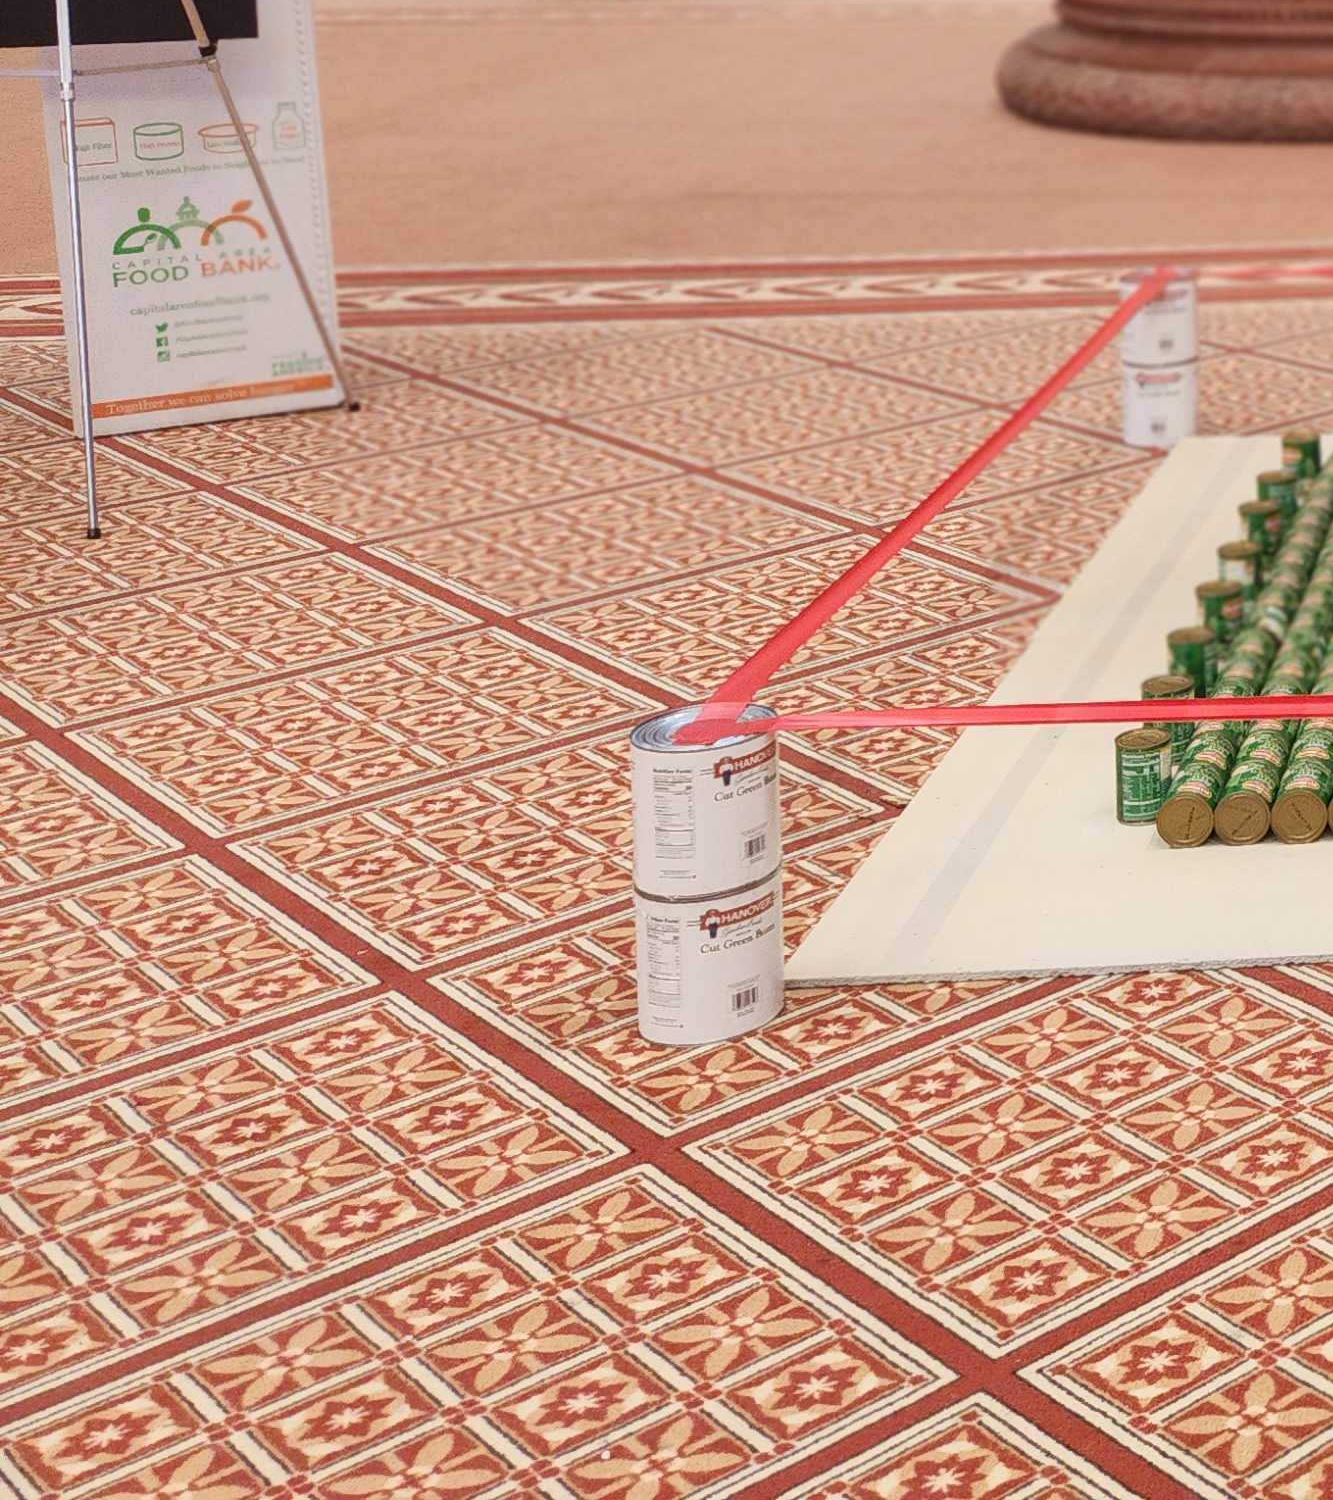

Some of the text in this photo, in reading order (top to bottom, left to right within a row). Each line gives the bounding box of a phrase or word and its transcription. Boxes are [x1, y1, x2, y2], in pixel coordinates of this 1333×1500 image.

[112, 253, 203, 271] CAPITAL
[112, 266, 189, 287] FOOD
[714, 782, 762, 801] Cut Green
[700, 944, 720, 953] Cut
